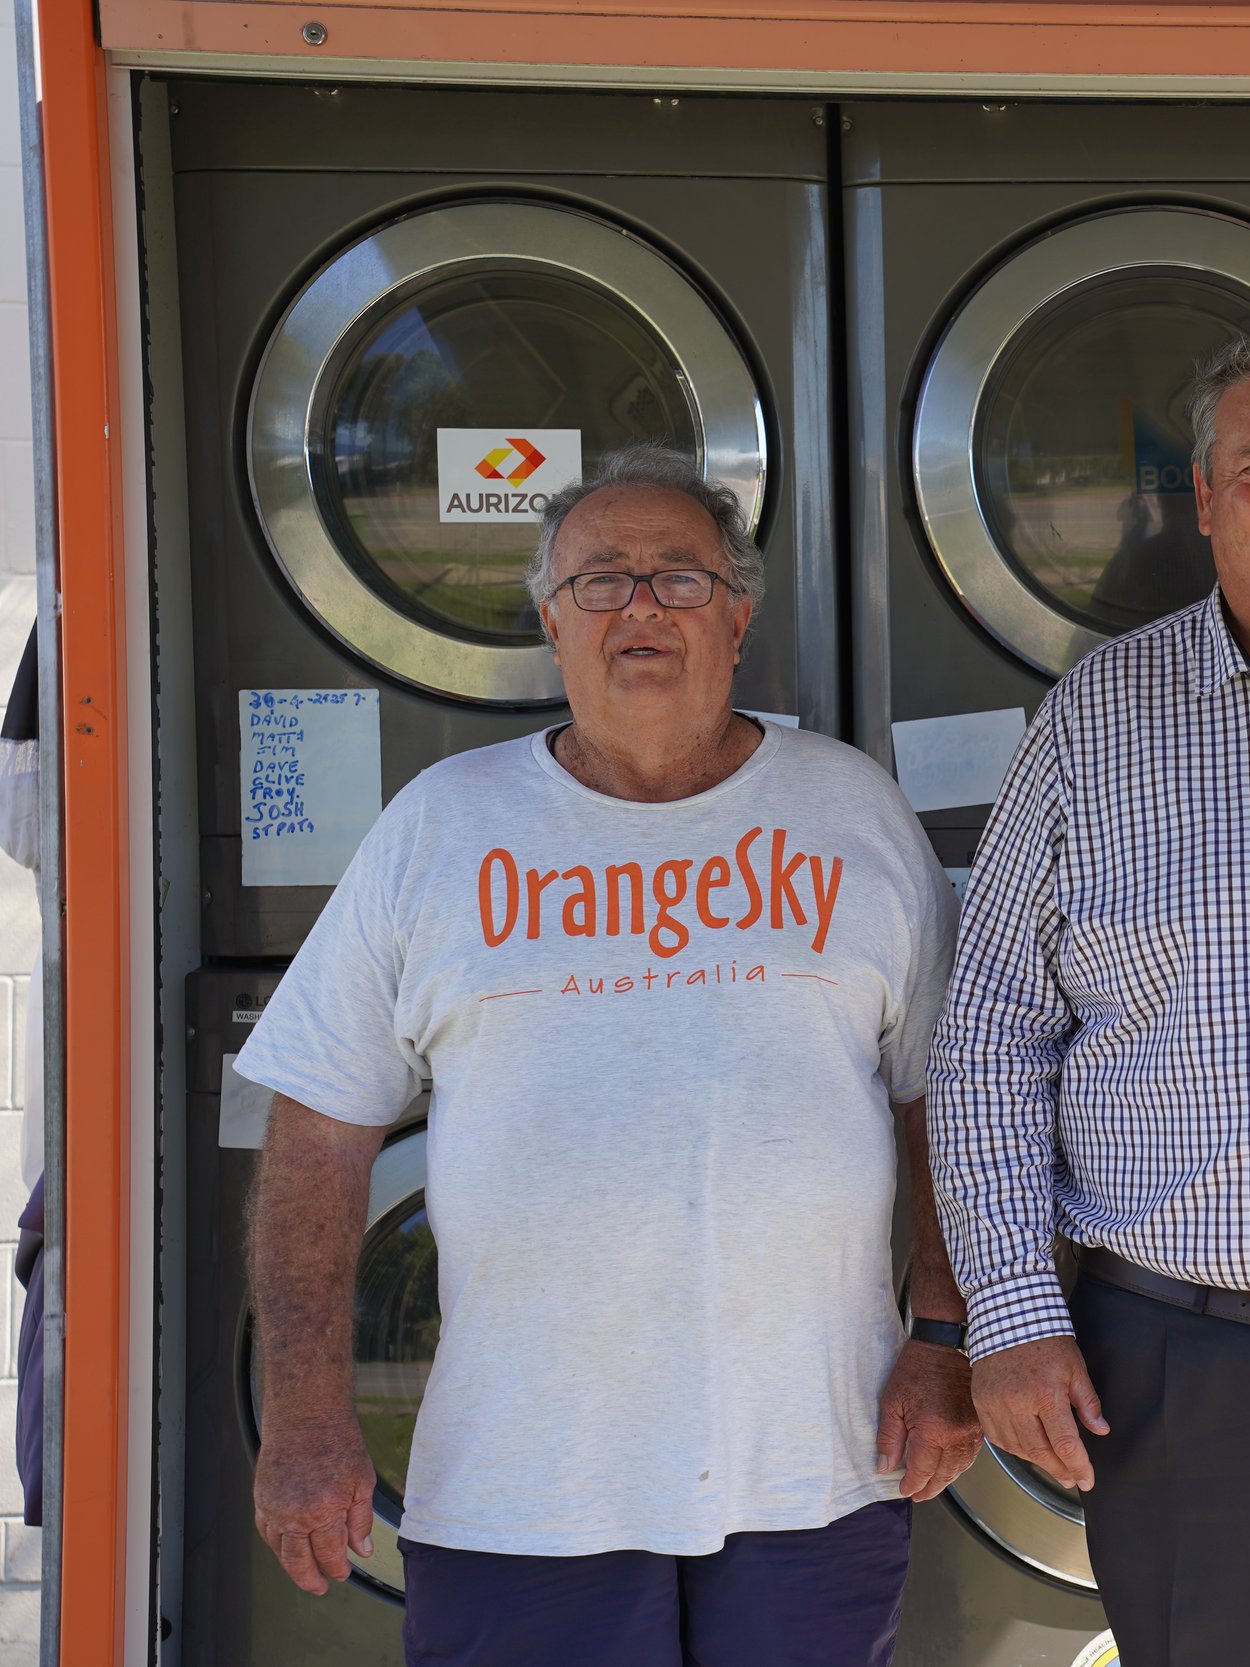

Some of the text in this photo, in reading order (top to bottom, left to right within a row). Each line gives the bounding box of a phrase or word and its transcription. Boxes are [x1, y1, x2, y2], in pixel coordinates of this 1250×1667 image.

[446, 493, 558, 513] AURIZO
[250, 712, 299, 728] DAVID
[253, 760, 299, 773] DAVE
[245, 801, 304, 822] JOSH
[478, 826, 844, 958] OrangeSky
[560, 960, 765, 995] Australia
[236, 1012, 262, 1020] WASH
